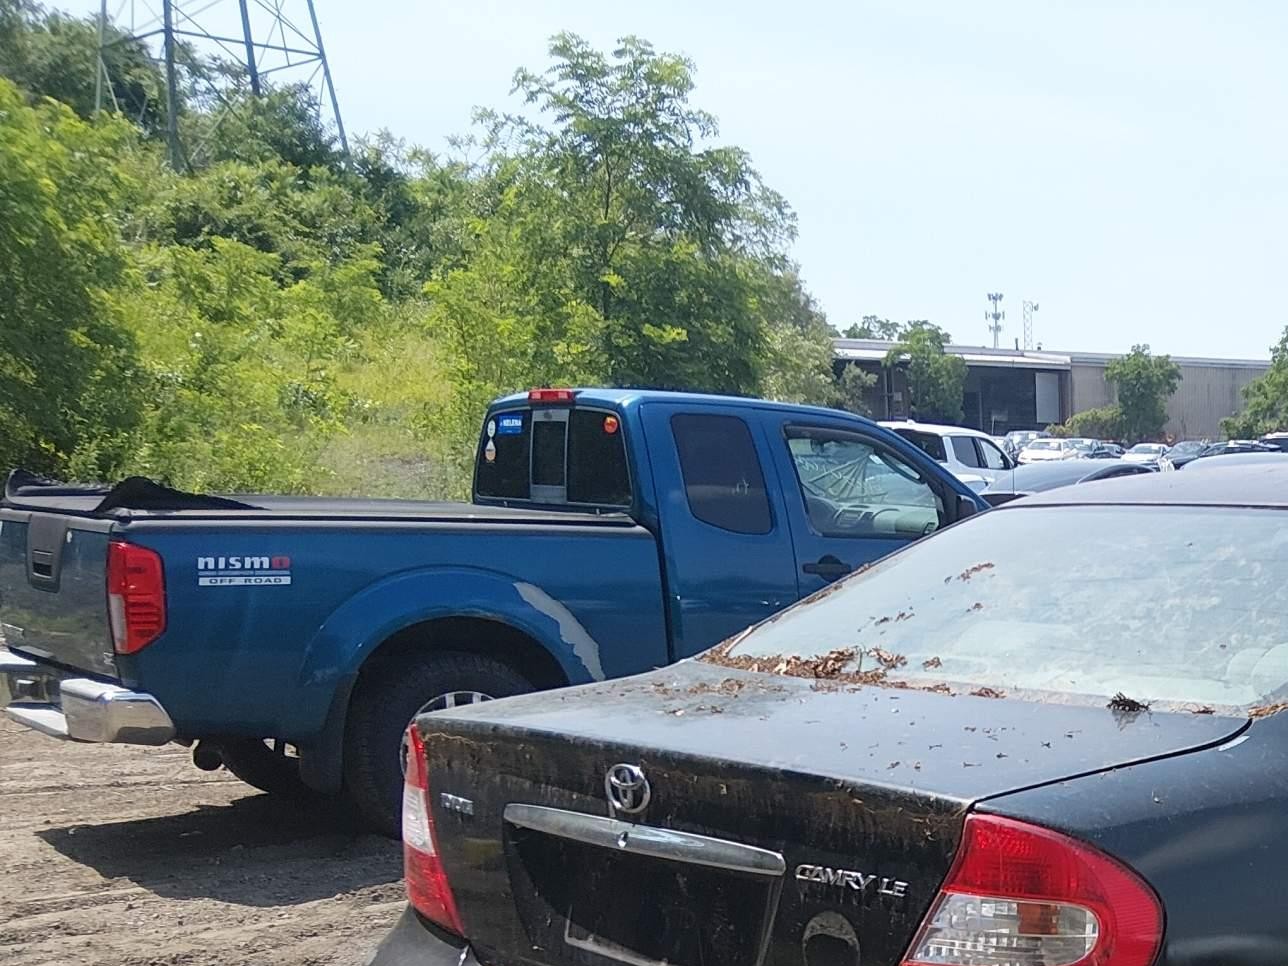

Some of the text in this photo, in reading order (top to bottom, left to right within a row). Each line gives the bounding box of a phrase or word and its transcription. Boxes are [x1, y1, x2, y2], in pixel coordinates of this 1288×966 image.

[197, 556, 290, 570] nismo
[795, 864, 909, 897] CAMRY LE
